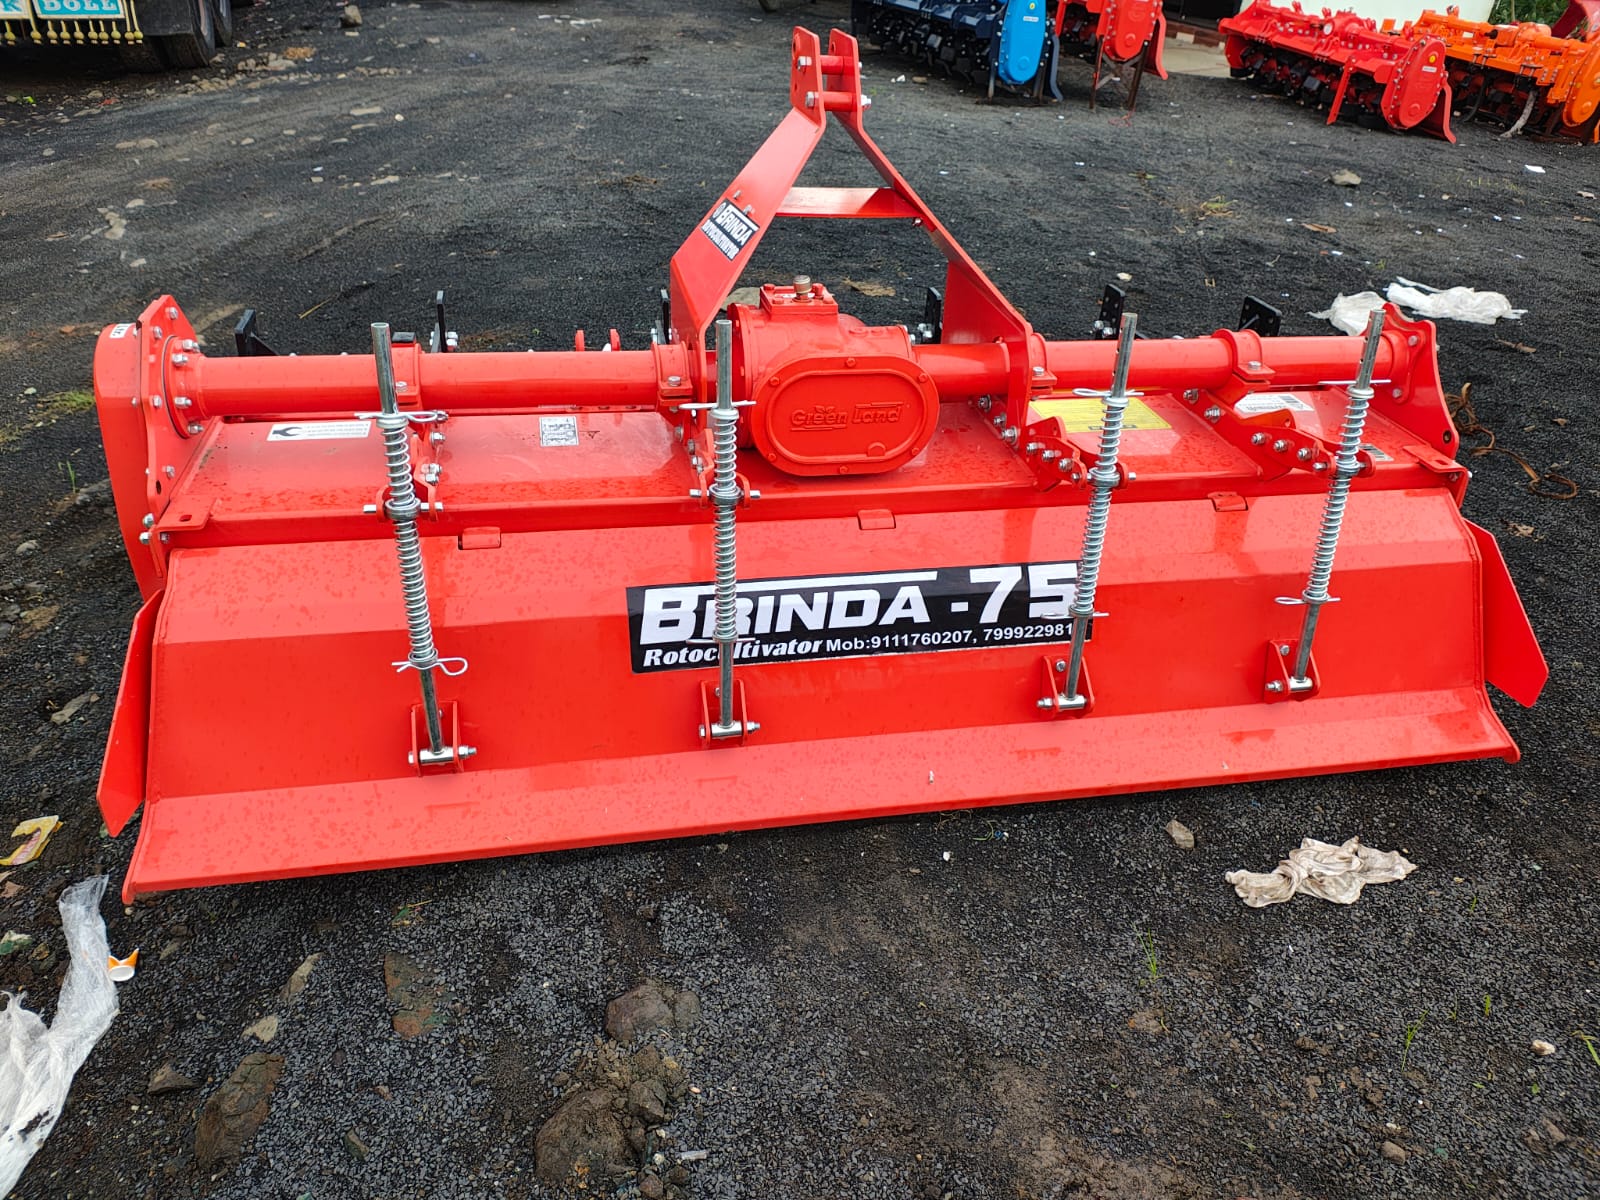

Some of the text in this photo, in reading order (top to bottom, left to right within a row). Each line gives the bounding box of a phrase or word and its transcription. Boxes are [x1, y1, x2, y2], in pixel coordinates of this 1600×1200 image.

[713, 202, 760, 246] BRINDA
[791, 404, 903, 427] Green Land
[640, 571, 937, 645] BRINDA
[643, 639, 823, 667] Rotocltivator
[984, 622, 1074, 641] 799922981
